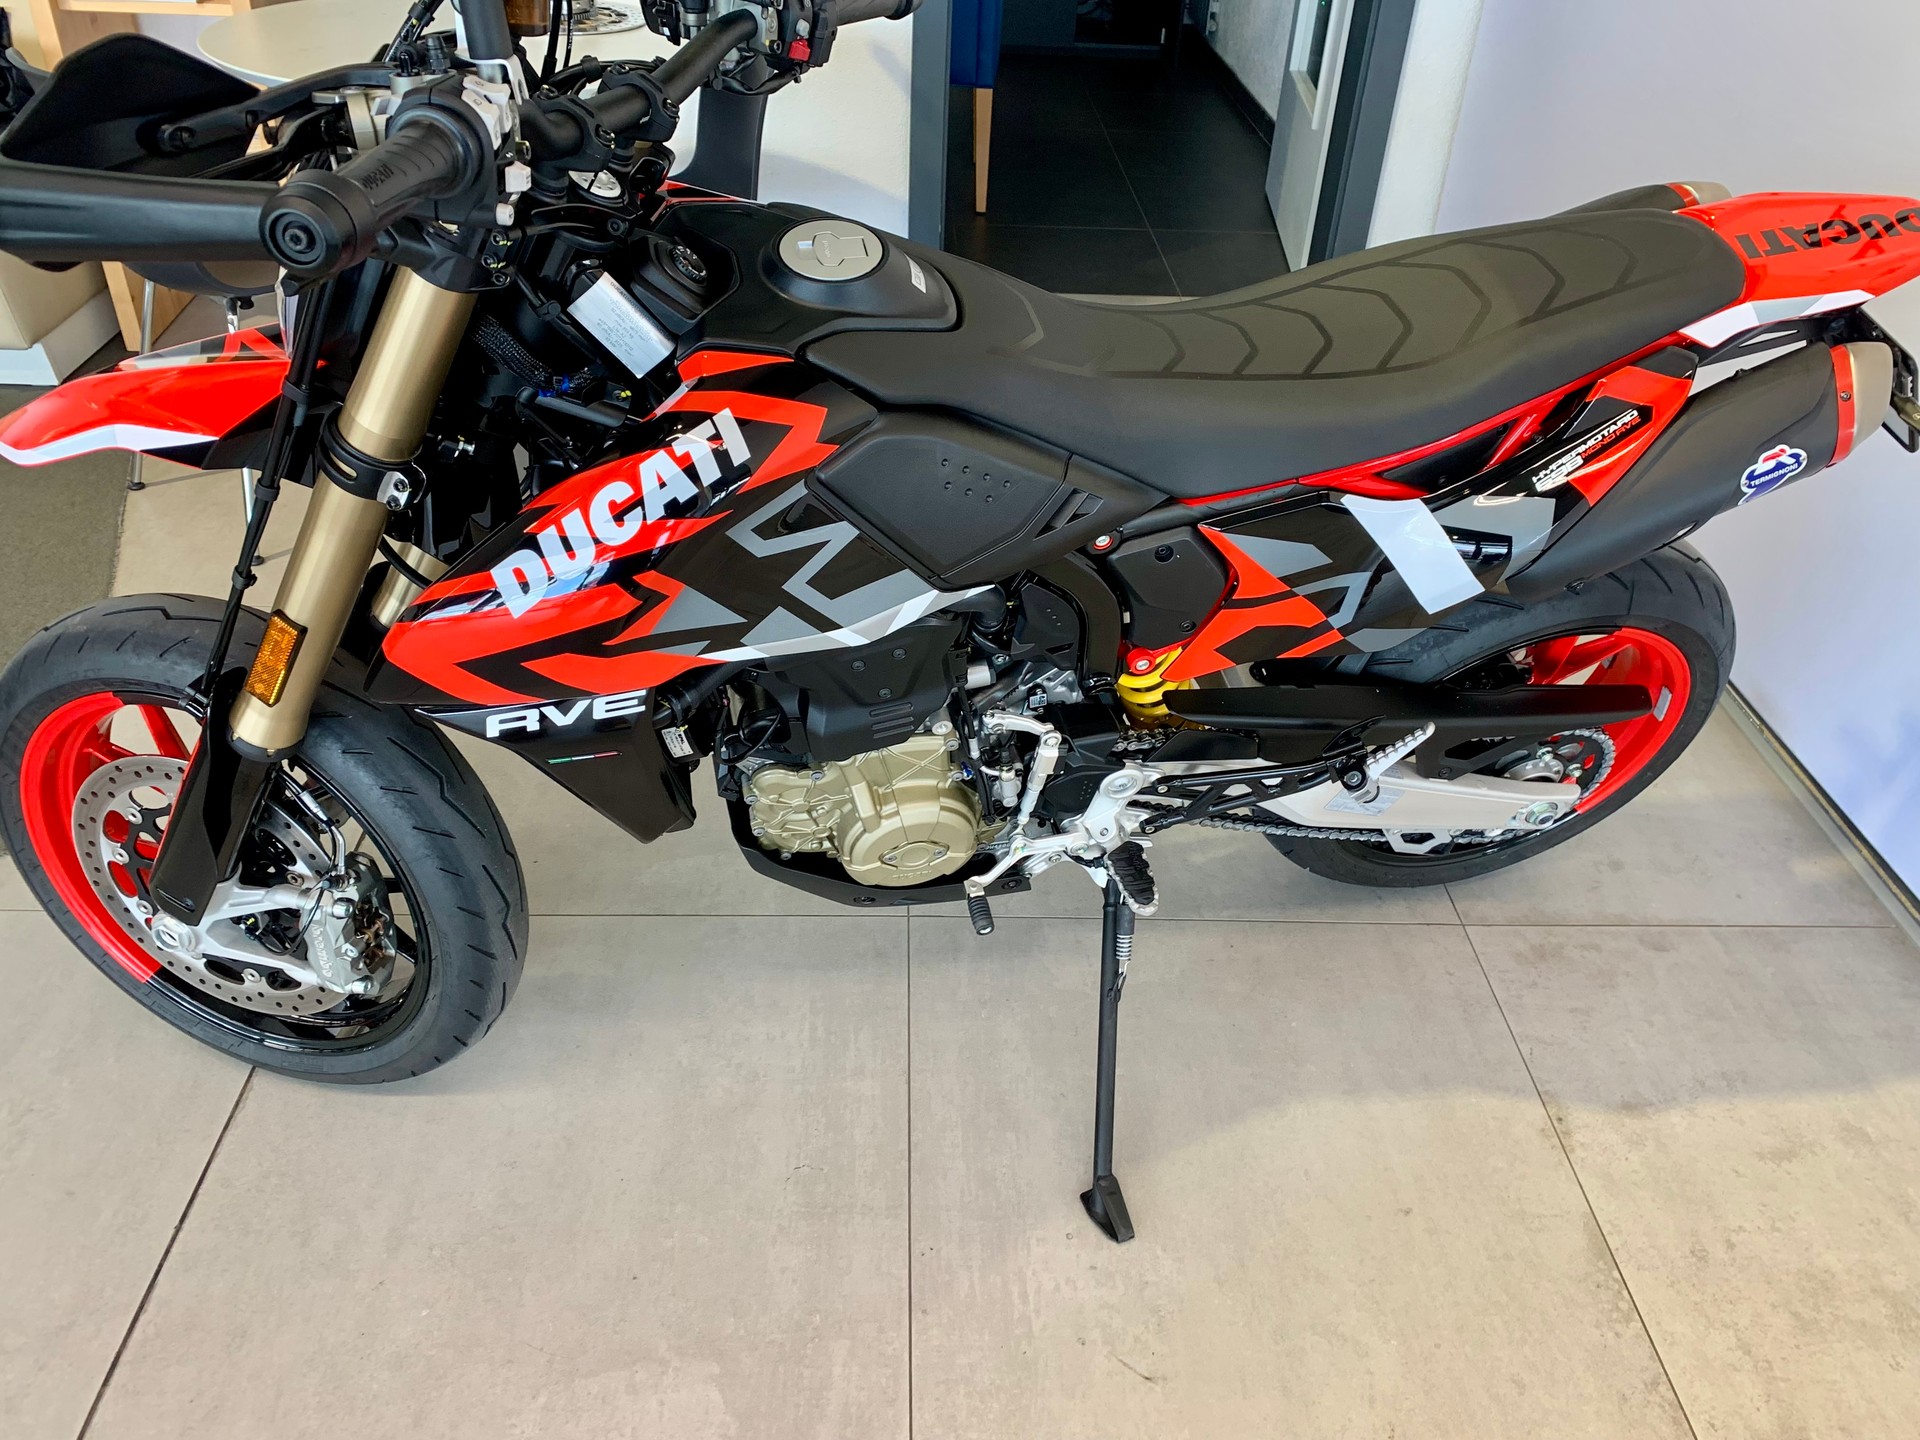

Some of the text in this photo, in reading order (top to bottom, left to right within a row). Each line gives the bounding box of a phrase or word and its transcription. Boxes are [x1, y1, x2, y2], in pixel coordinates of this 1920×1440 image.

[1532, 409, 1639, 483] HYPERMOTARD
[1580, 415, 1642, 459] MONO RVE
[1750, 462, 1799, 487] TERMIGNONI
[489, 408, 752, 620] DUCATI
[486, 689, 647, 738] RVE
[312, 924, 334, 978] brembo
